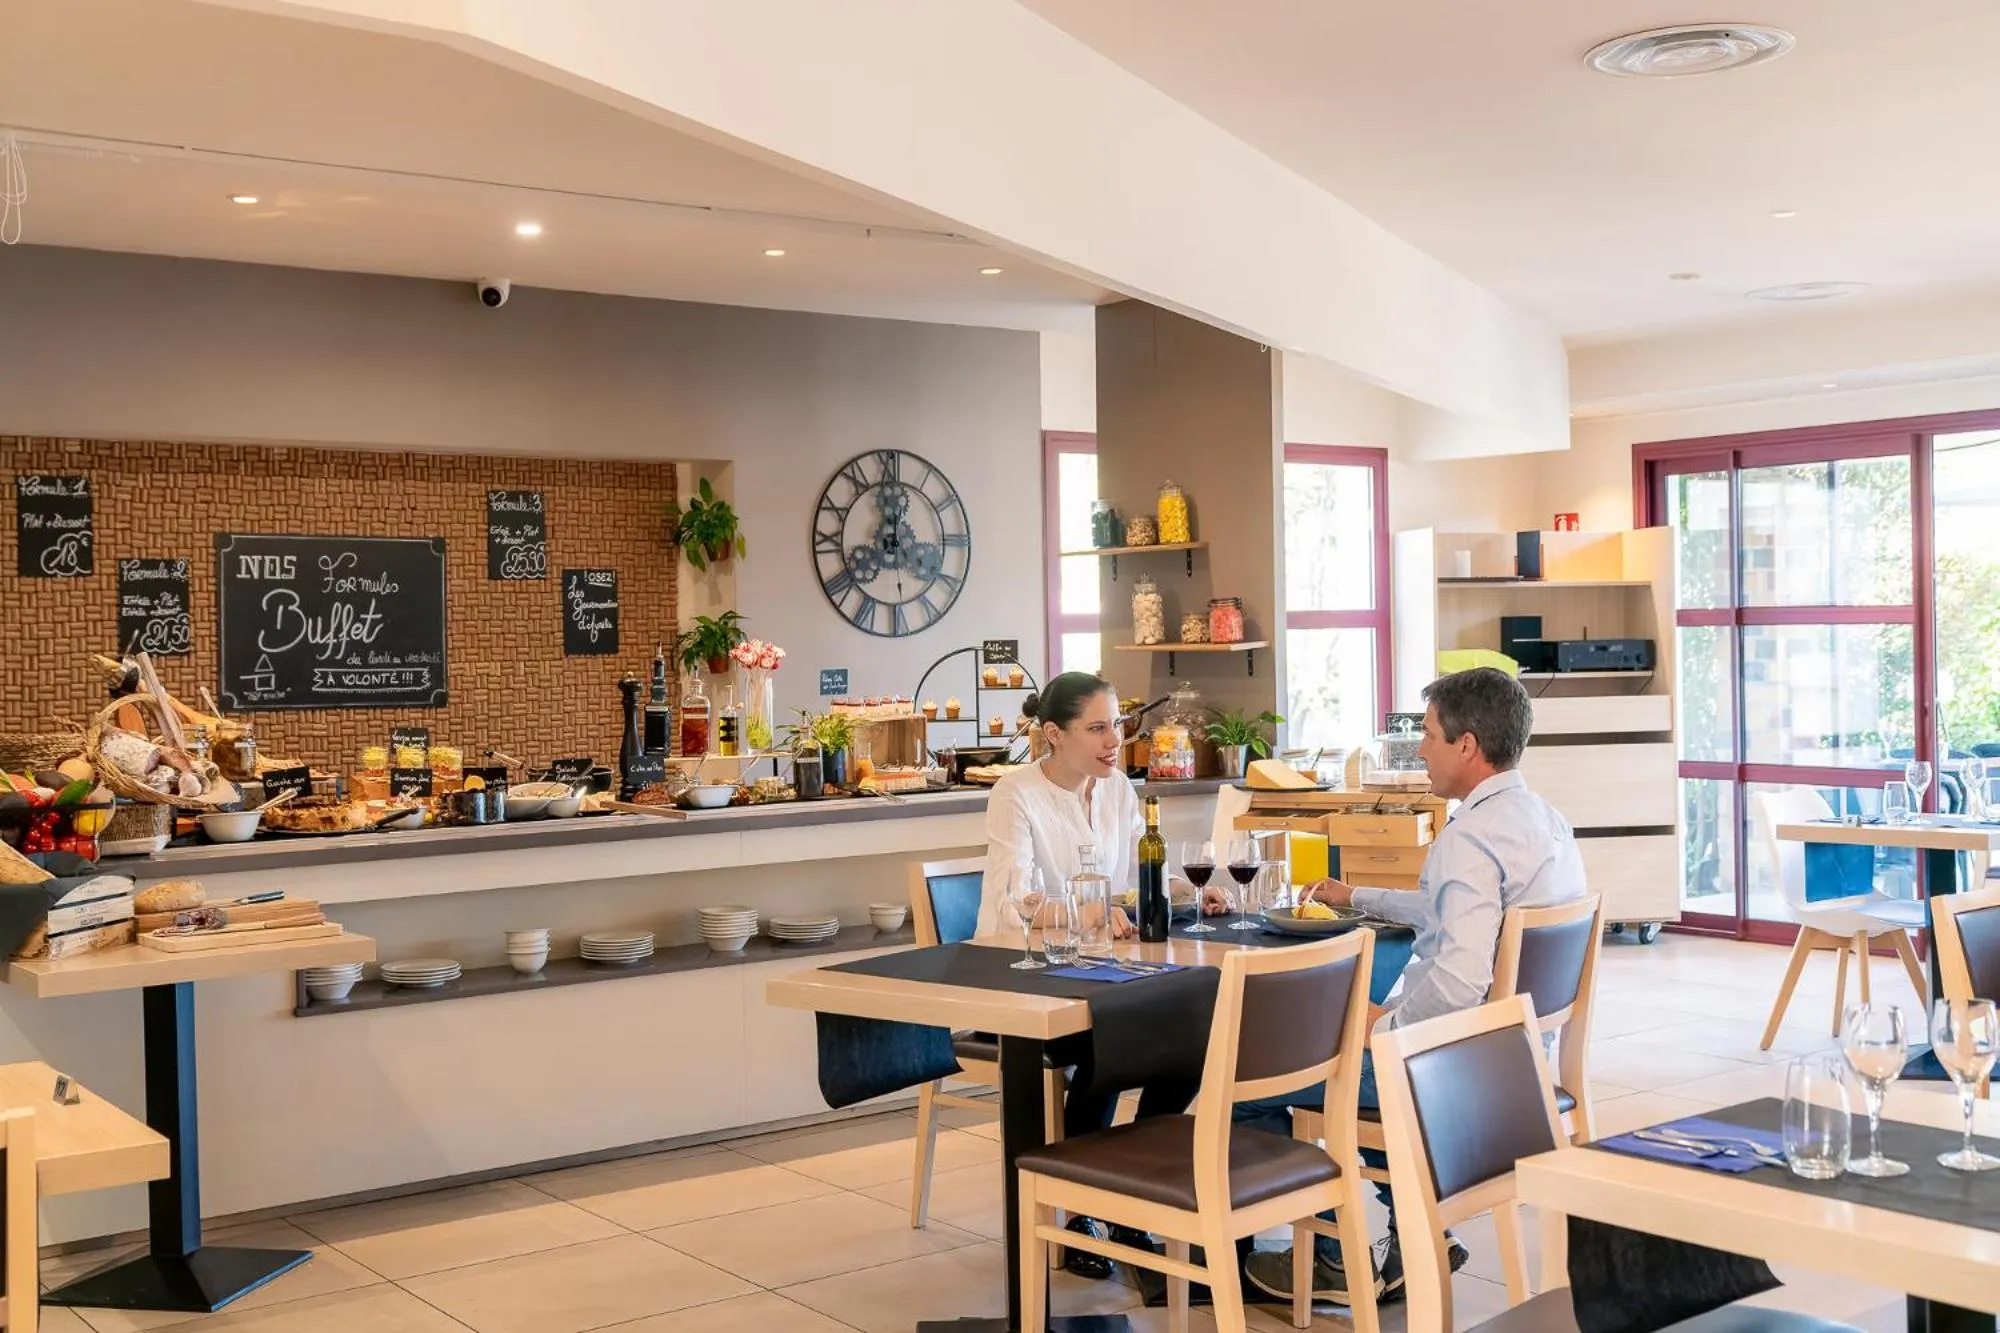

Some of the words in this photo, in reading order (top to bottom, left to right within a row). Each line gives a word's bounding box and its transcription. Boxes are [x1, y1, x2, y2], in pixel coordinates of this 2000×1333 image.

[820, 494, 848, 521] X
[816, 530, 842, 553] IX
[236, 555, 297, 580] NOS
[258, 588, 384, 660] Buffet
